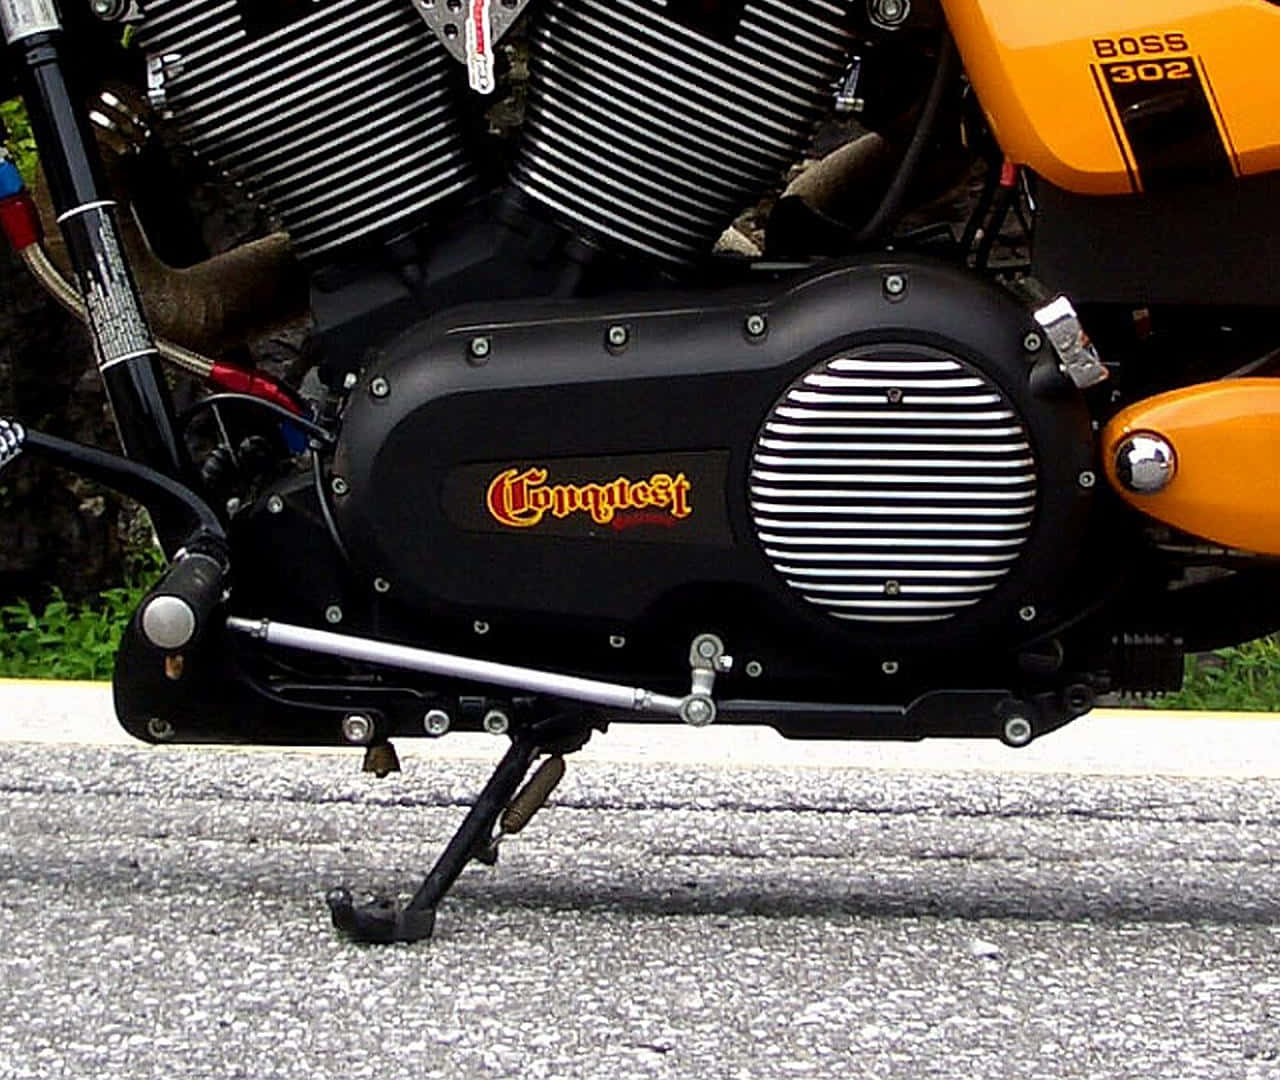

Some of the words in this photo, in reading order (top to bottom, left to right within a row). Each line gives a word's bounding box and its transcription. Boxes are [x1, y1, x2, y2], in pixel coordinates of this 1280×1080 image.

[1093, 33, 1189, 58] BOSS
[1110, 62, 1193, 83] 302
[487, 468, 692, 526] Conquest
